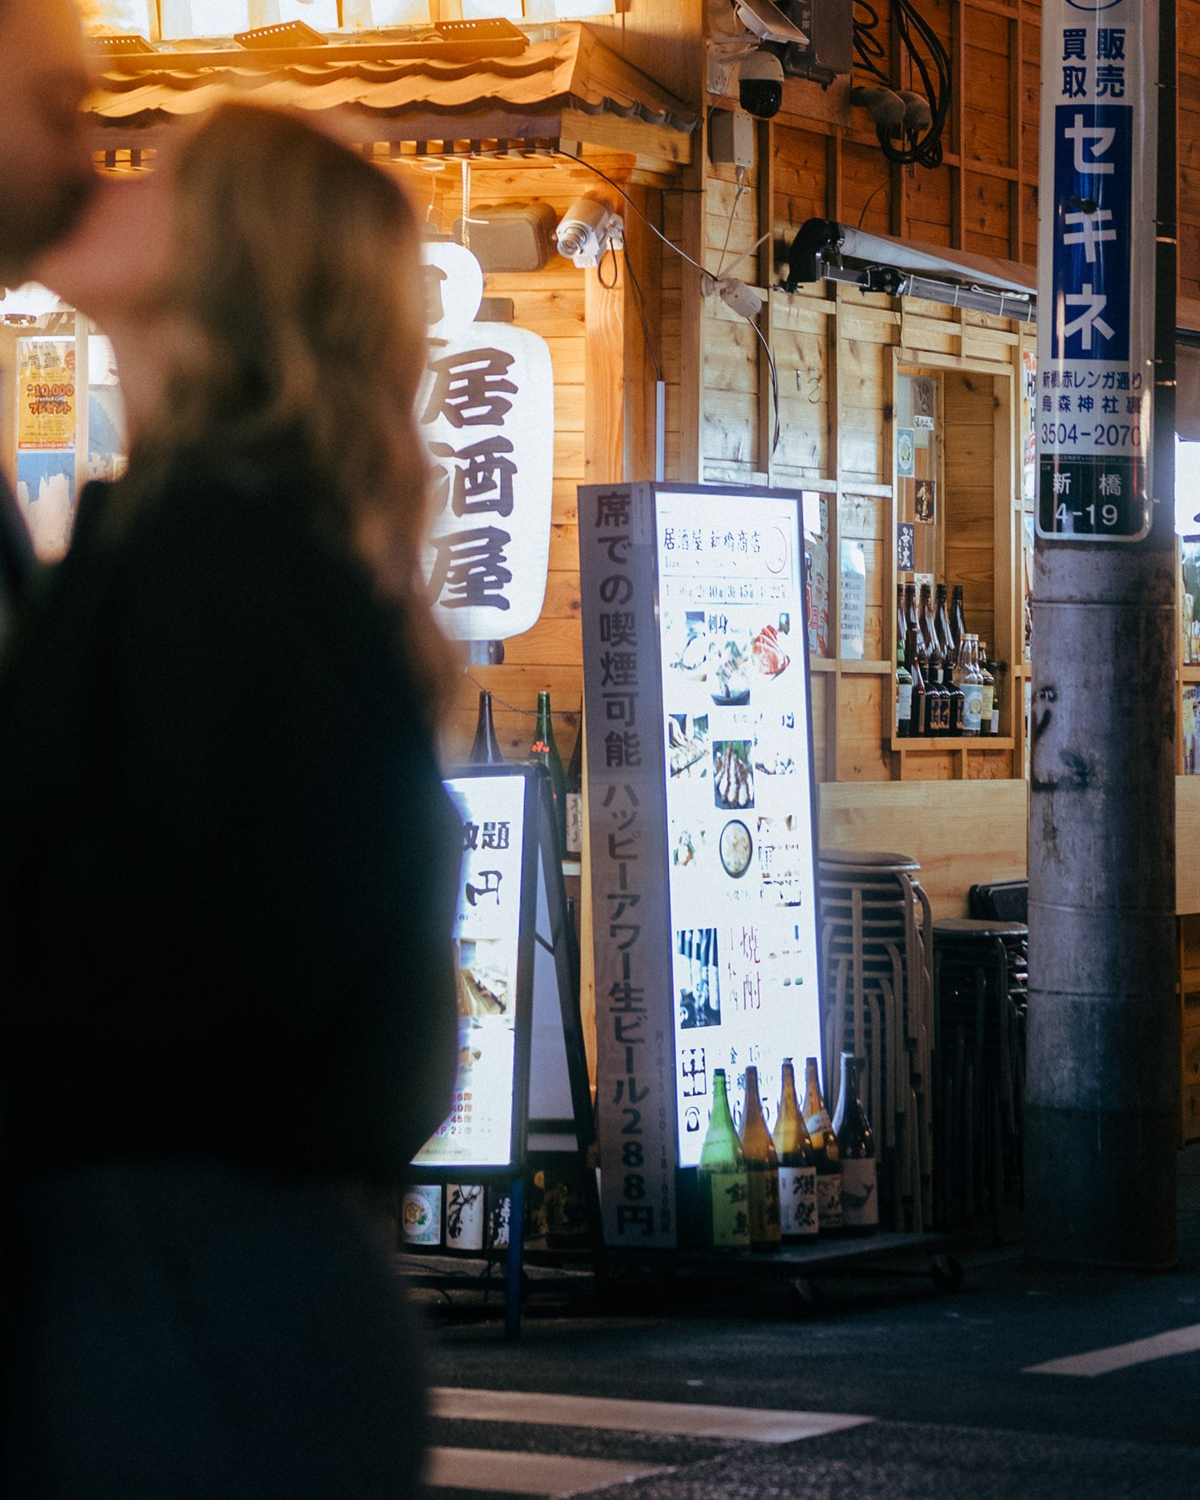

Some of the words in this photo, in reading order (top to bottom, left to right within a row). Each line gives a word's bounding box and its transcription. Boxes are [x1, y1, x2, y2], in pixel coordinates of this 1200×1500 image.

[1063, 113, 1118, 351] セキネ
[421, 347, 519, 611] 居酒屋
[1055, 502, 1119, 526] 4-19
[595, 491, 642, 768] 席での喫煙可能
